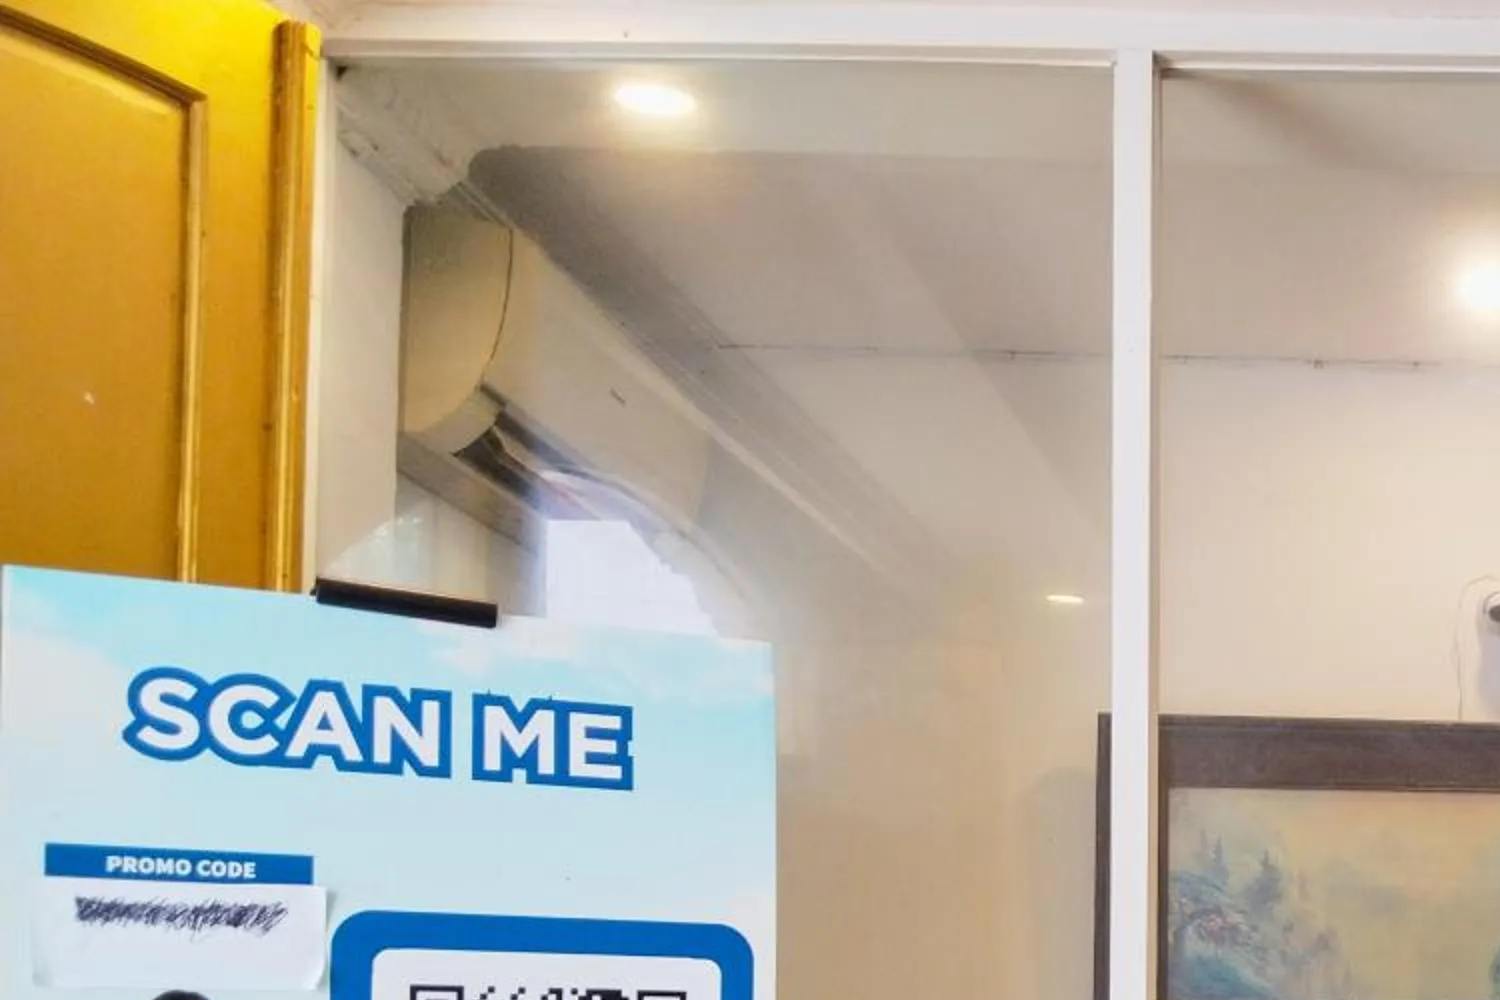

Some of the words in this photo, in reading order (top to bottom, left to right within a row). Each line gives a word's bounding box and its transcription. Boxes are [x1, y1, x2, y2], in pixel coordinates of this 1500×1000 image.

[122, 667, 452, 778] SCAN
[472, 694, 634, 790] ME
[105, 855, 192, 877] PROMO
[196, 858, 257, 880] CODE
